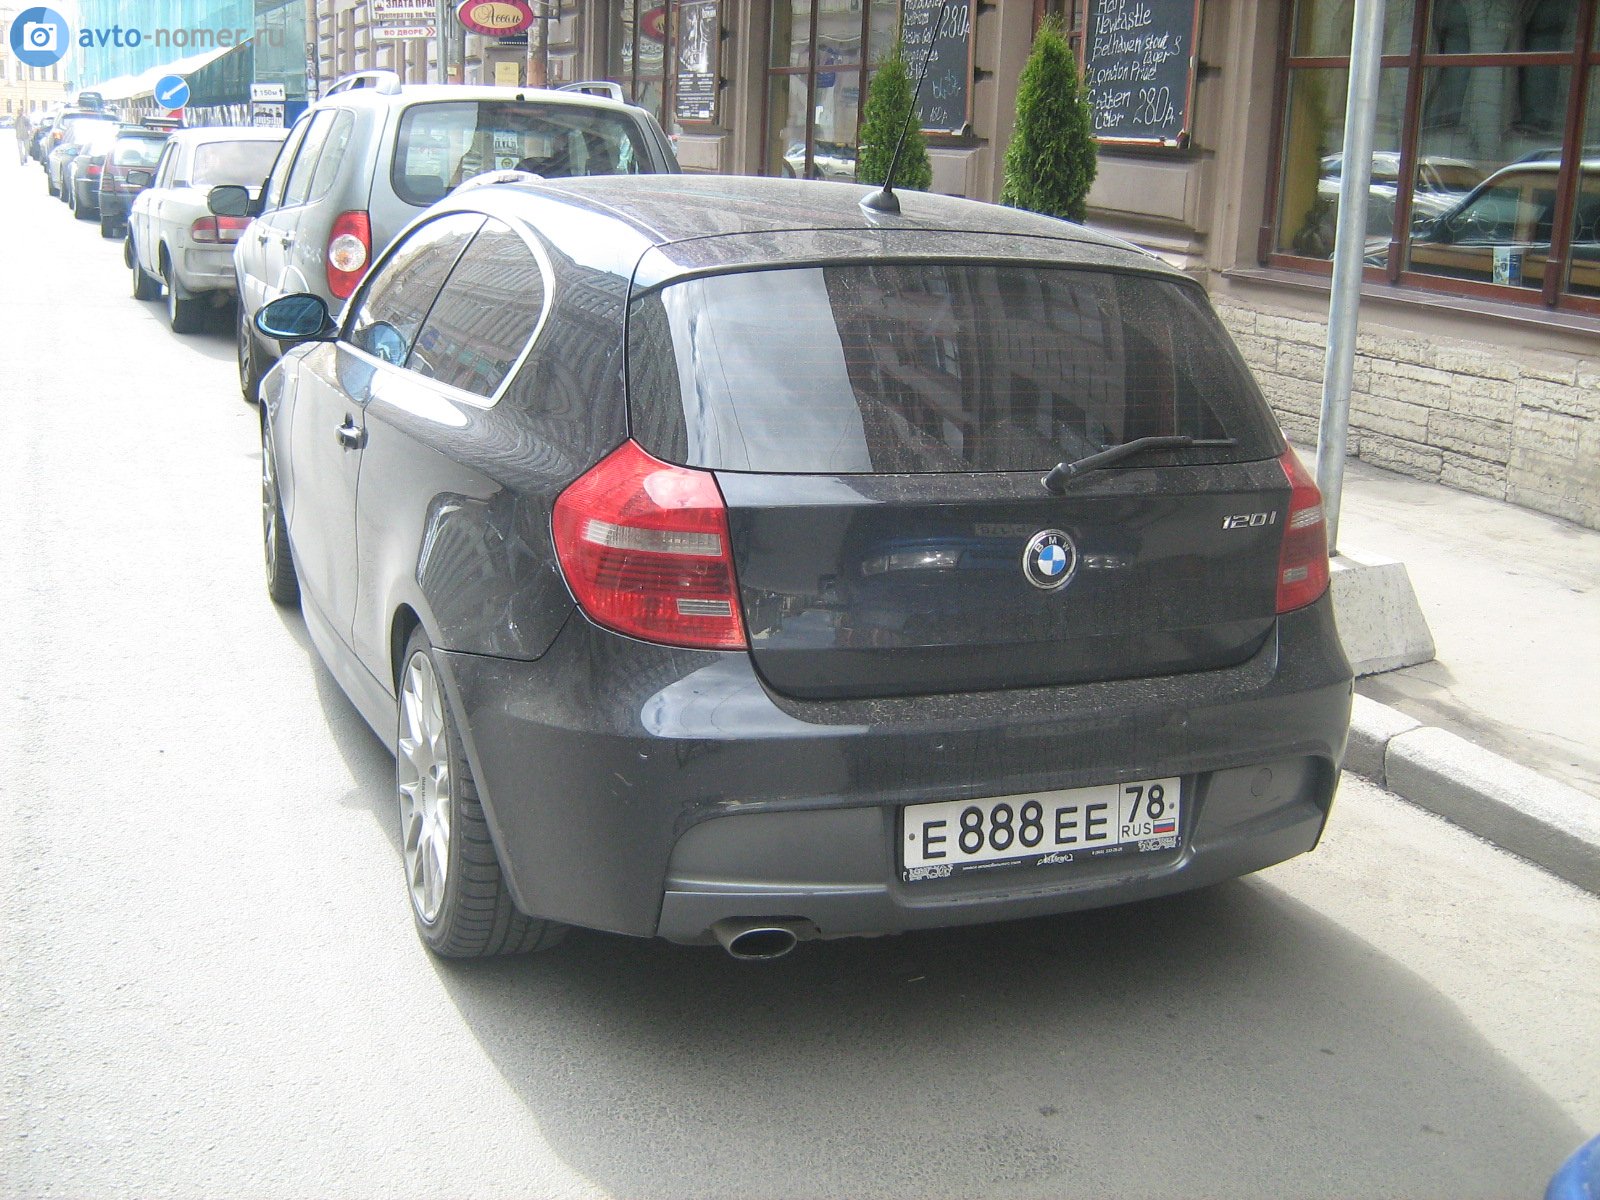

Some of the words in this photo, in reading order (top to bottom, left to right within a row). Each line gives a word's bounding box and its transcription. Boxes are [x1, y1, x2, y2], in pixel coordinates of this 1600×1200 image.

[1034, 536, 1071, 553] BMW
[1125, 784, 1165, 823] 78
[1121, 823, 1152, 838] RUS
